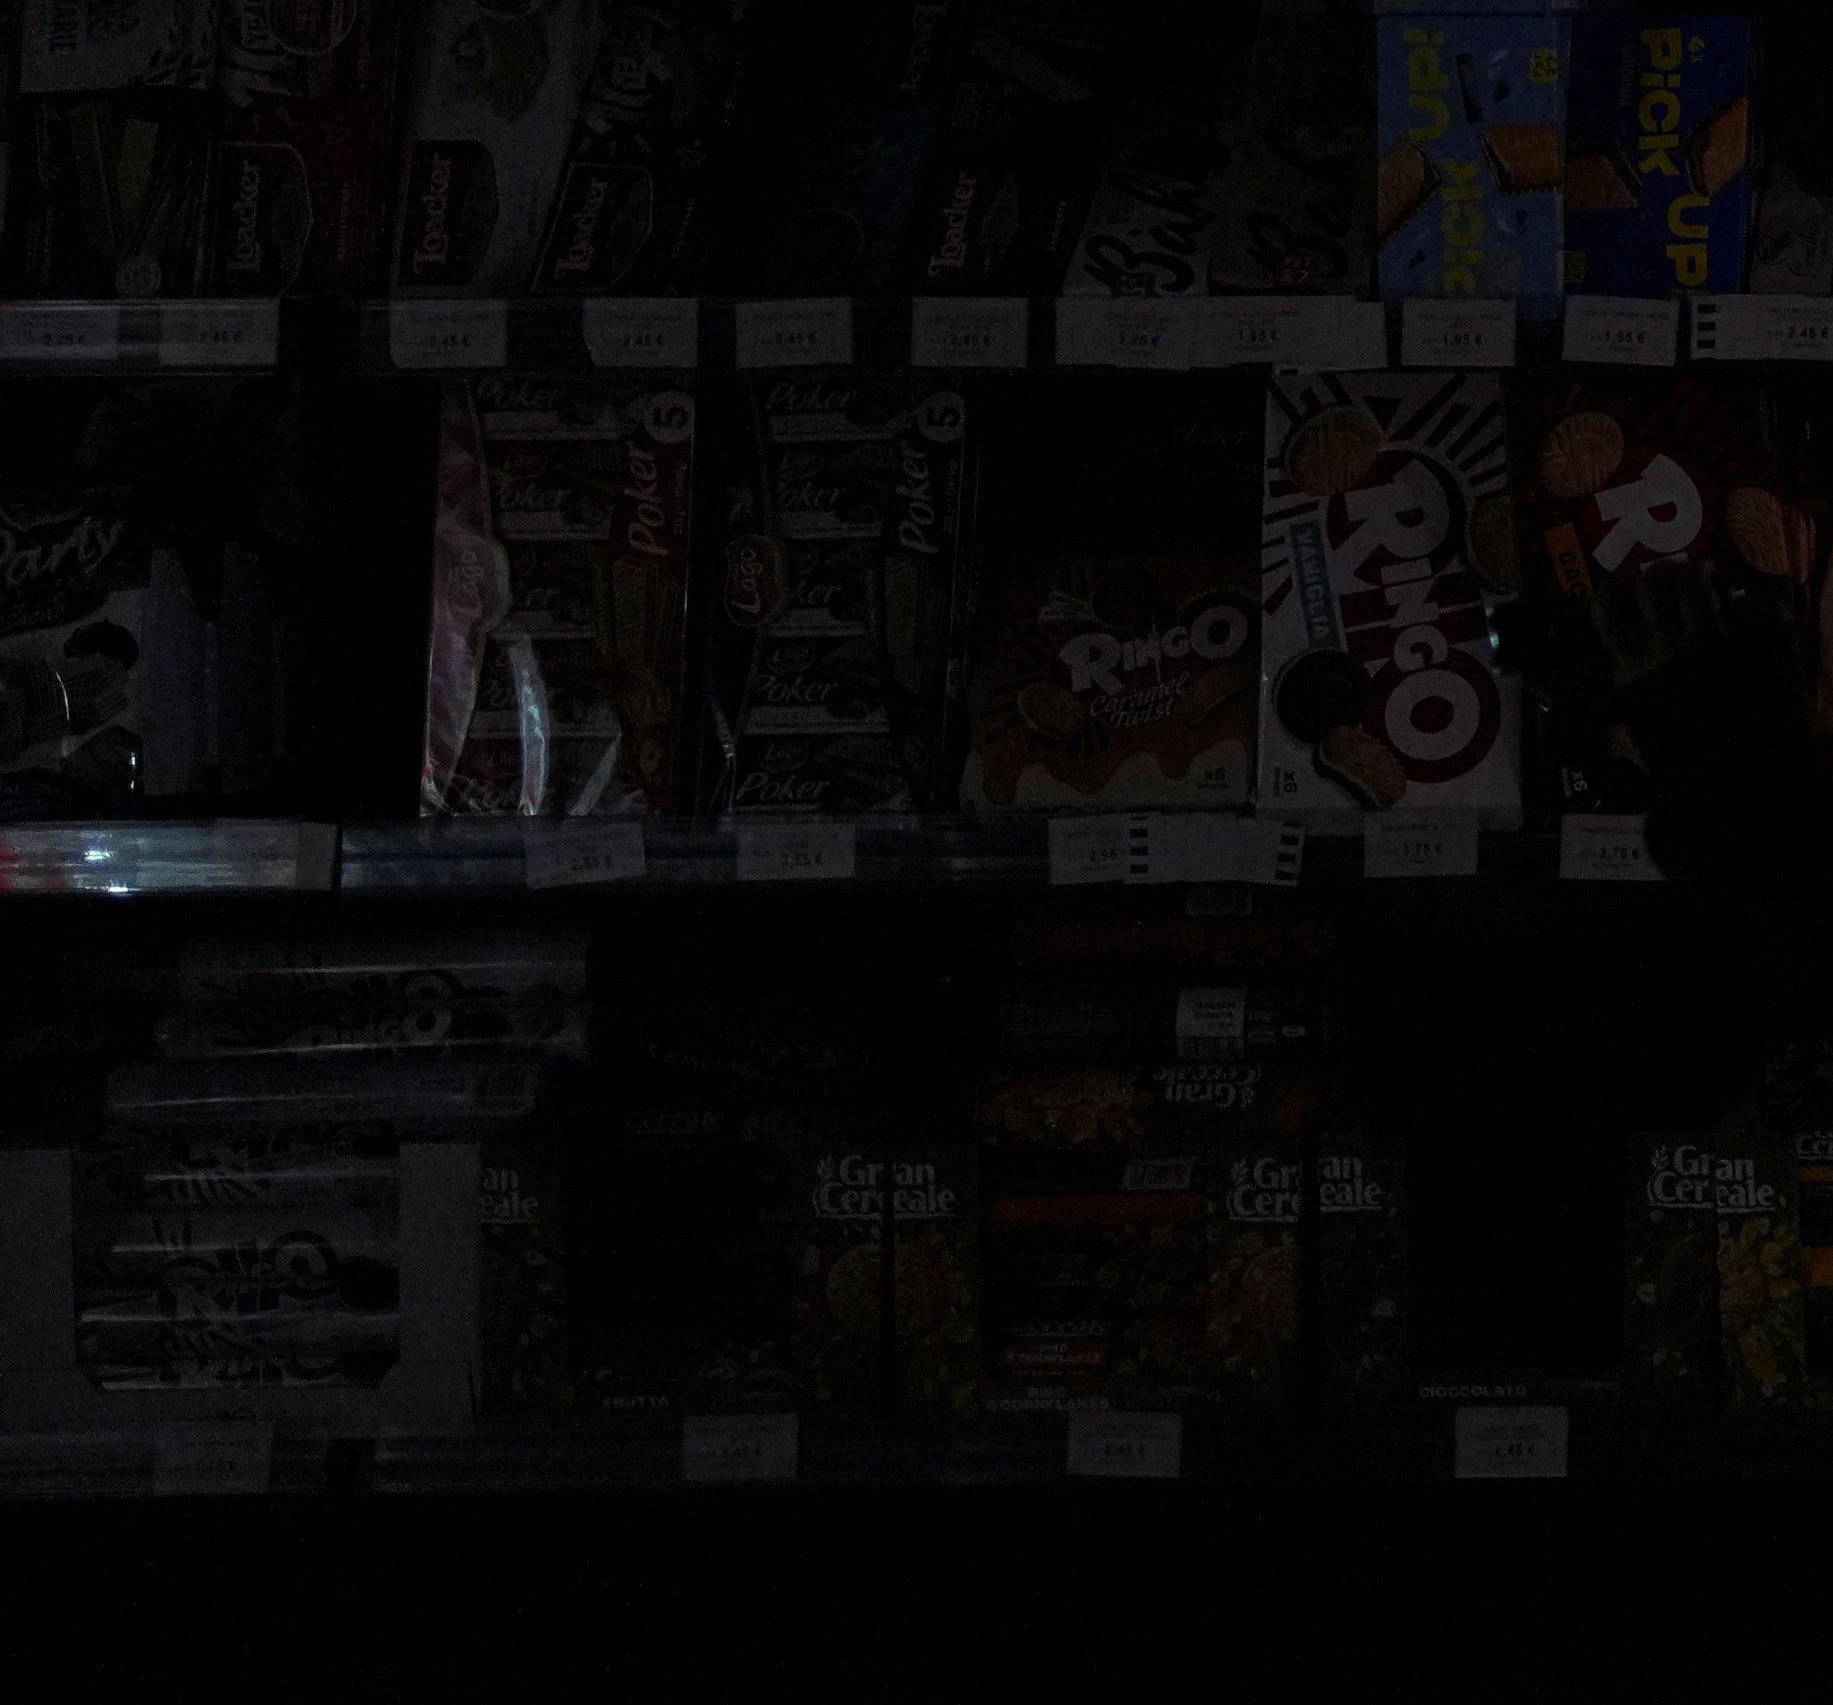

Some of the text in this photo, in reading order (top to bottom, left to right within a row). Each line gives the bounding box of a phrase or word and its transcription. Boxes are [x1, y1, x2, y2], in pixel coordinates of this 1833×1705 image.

[413, 153, 452, 277] Loacker
[627, 438, 663, 557] Poker
[898, 438, 933, 556] Poker
[730, 547, 763, 617] Lago
[1330, 455, 1483, 764] RINGO
[1058, 606, 1248, 696] RINGO
